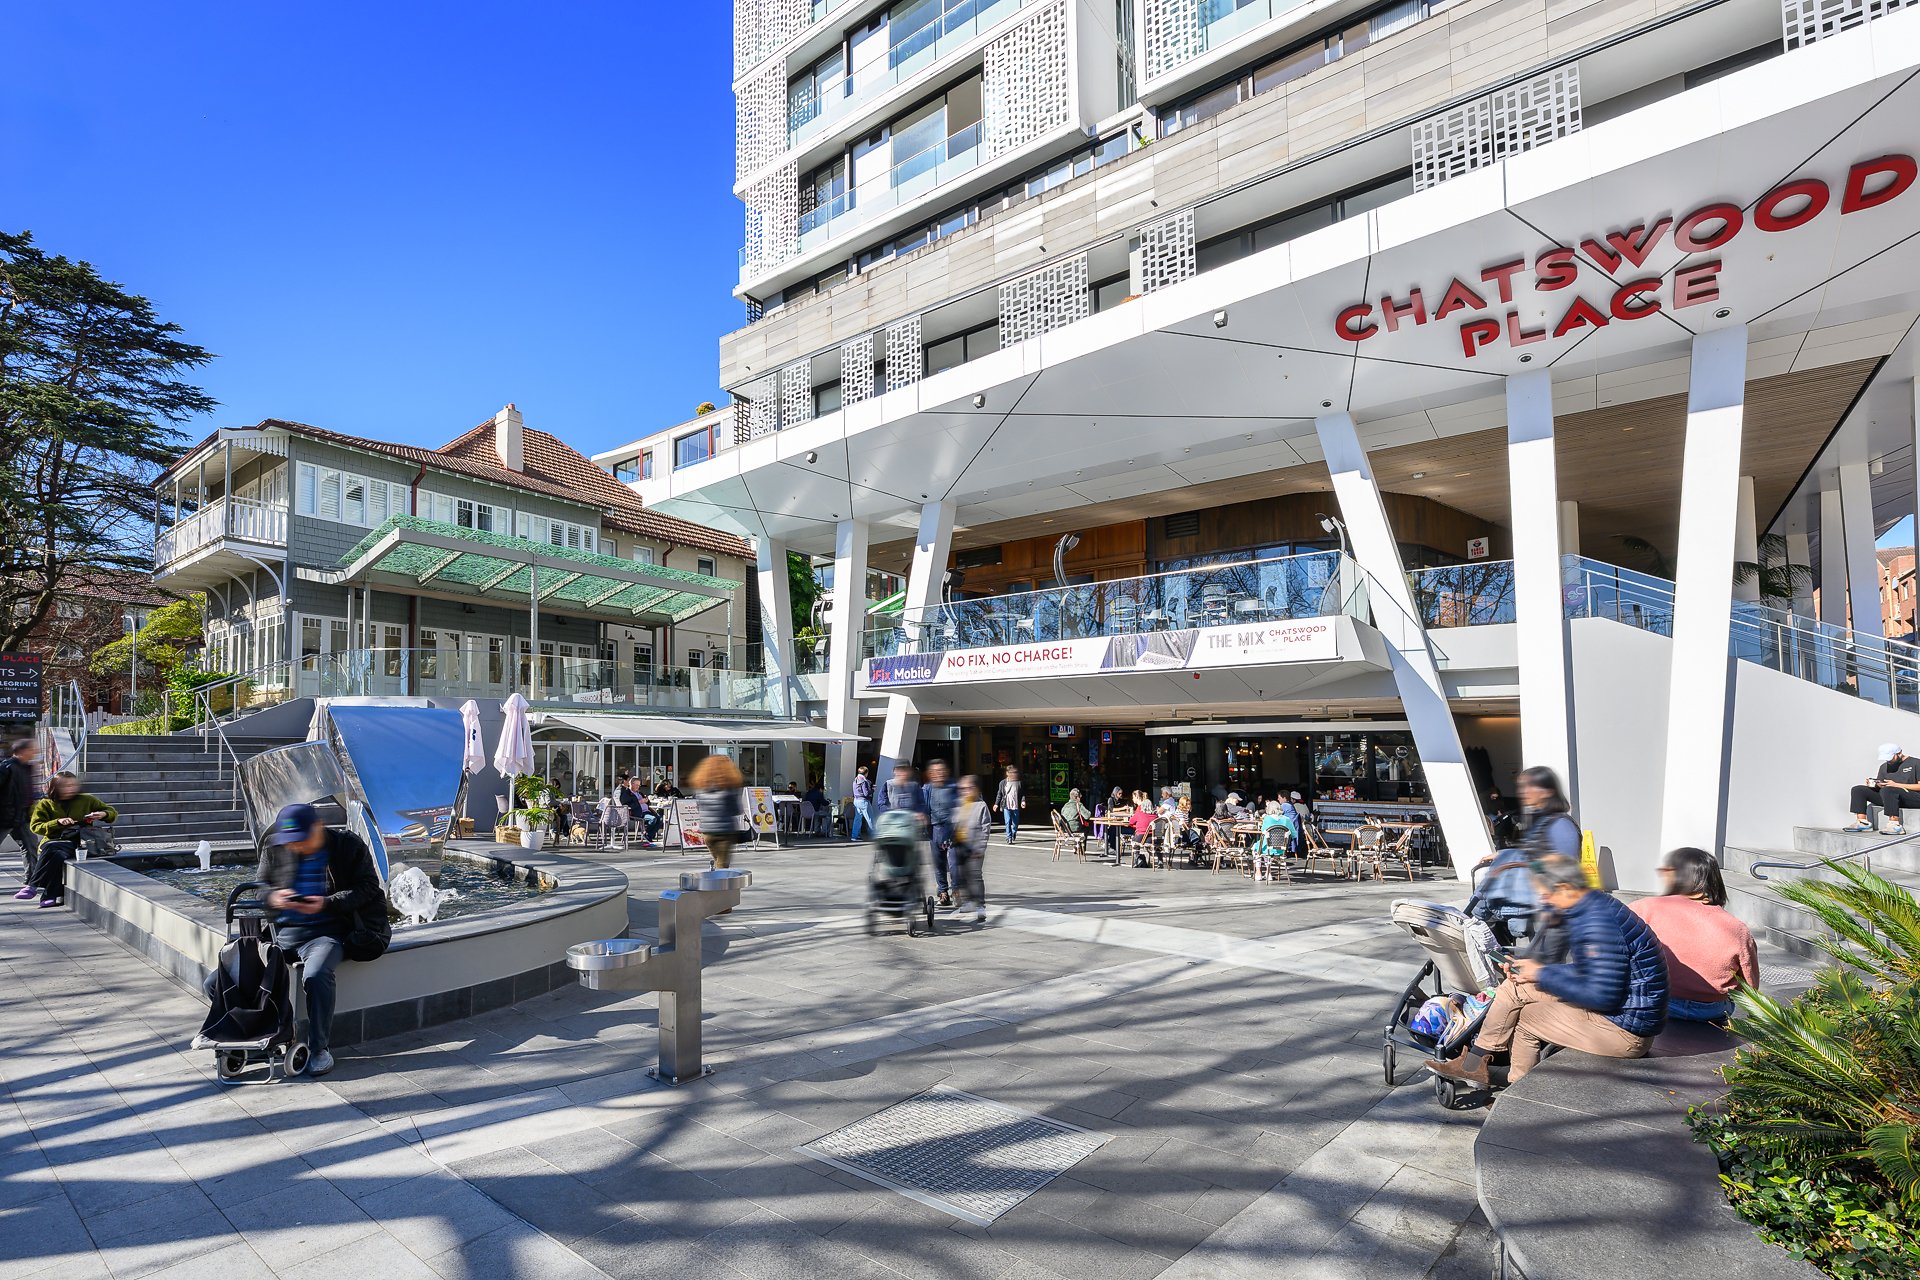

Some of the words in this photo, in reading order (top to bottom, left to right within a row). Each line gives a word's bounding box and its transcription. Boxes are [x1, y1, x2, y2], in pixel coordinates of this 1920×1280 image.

[1335, 153, 1918, 342] CHATSWOOD
[1460, 259, 1723, 358] PLACE
[1269, 625, 1327, 637] CHATSWOOD
[1283, 634, 1312, 643] PLACE
[1207, 633, 1233, 649] THE
[1238, 631, 1265, 647] MIX
[2, 655, 39, 663] PLACE
[947, 656, 965, 668] NO
[968, 654, 989, 668] FIX,
[992, 652, 1011, 665] NO
[1014, 647, 1073, 663] CHARGE!
[894, 667, 932, 680] Mobile
